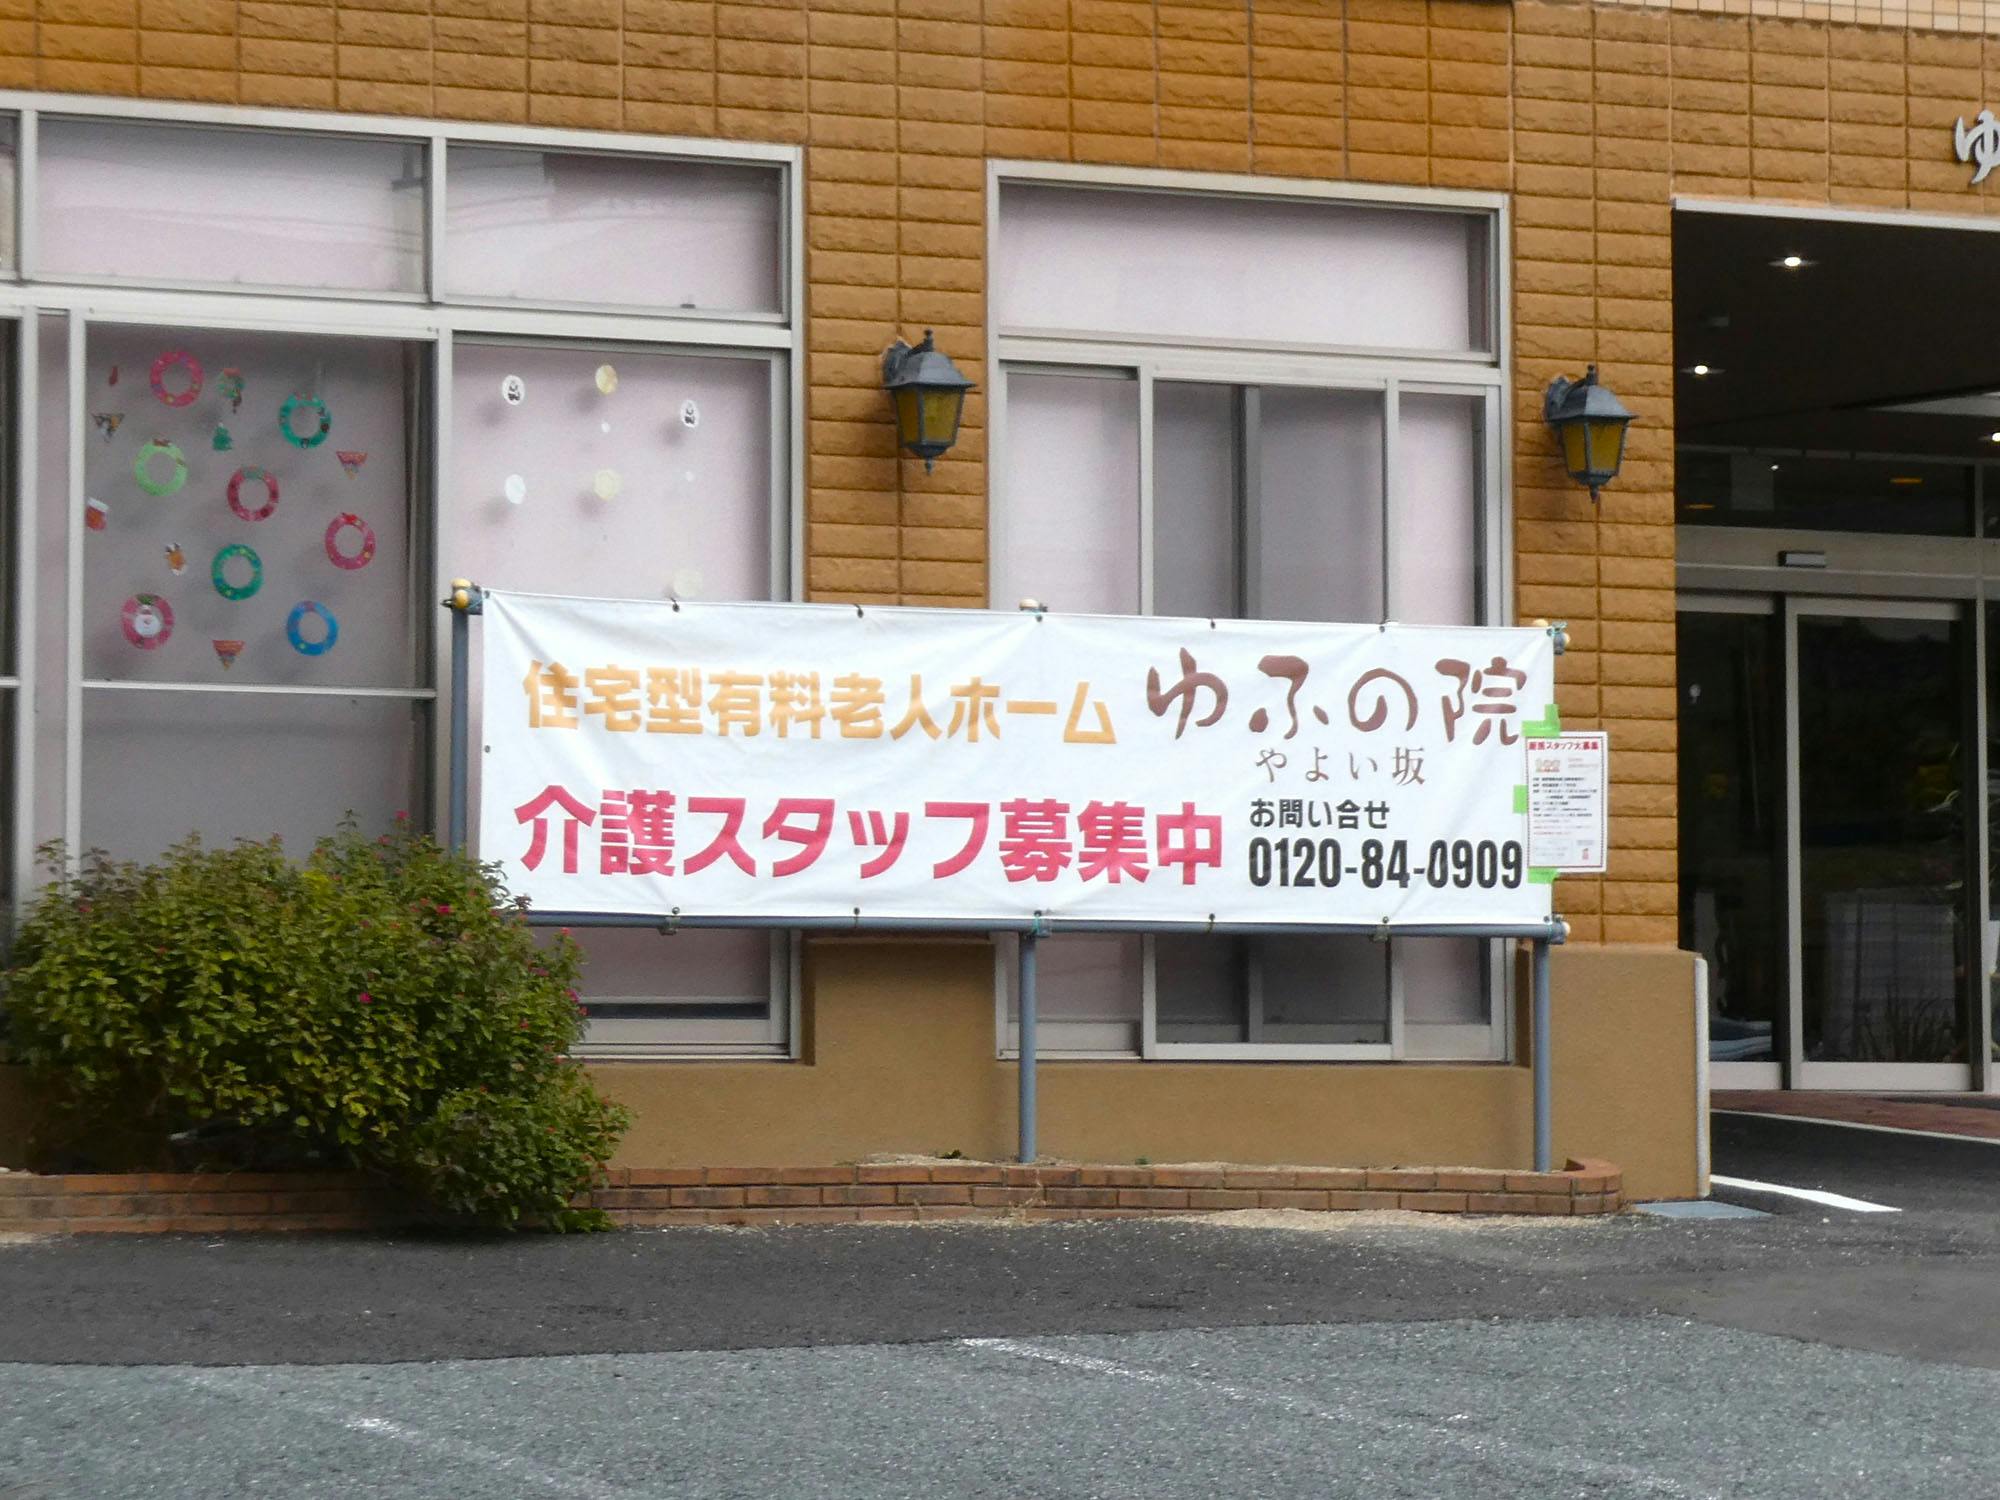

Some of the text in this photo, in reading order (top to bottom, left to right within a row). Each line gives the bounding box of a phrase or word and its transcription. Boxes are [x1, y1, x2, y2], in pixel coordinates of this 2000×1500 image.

[523, 659, 1117, 744] 住宅型有料老人ホーム
[1146, 647, 1527, 746] ゆふの院
[1255, 747, 1425, 786] やよい坂
[514, 785, 1222, 885] 介護スタッフ募集中
[1249, 799, 1390, 831] お問い合せ
[1248, 837, 1523, 889] 0120-84-0909
